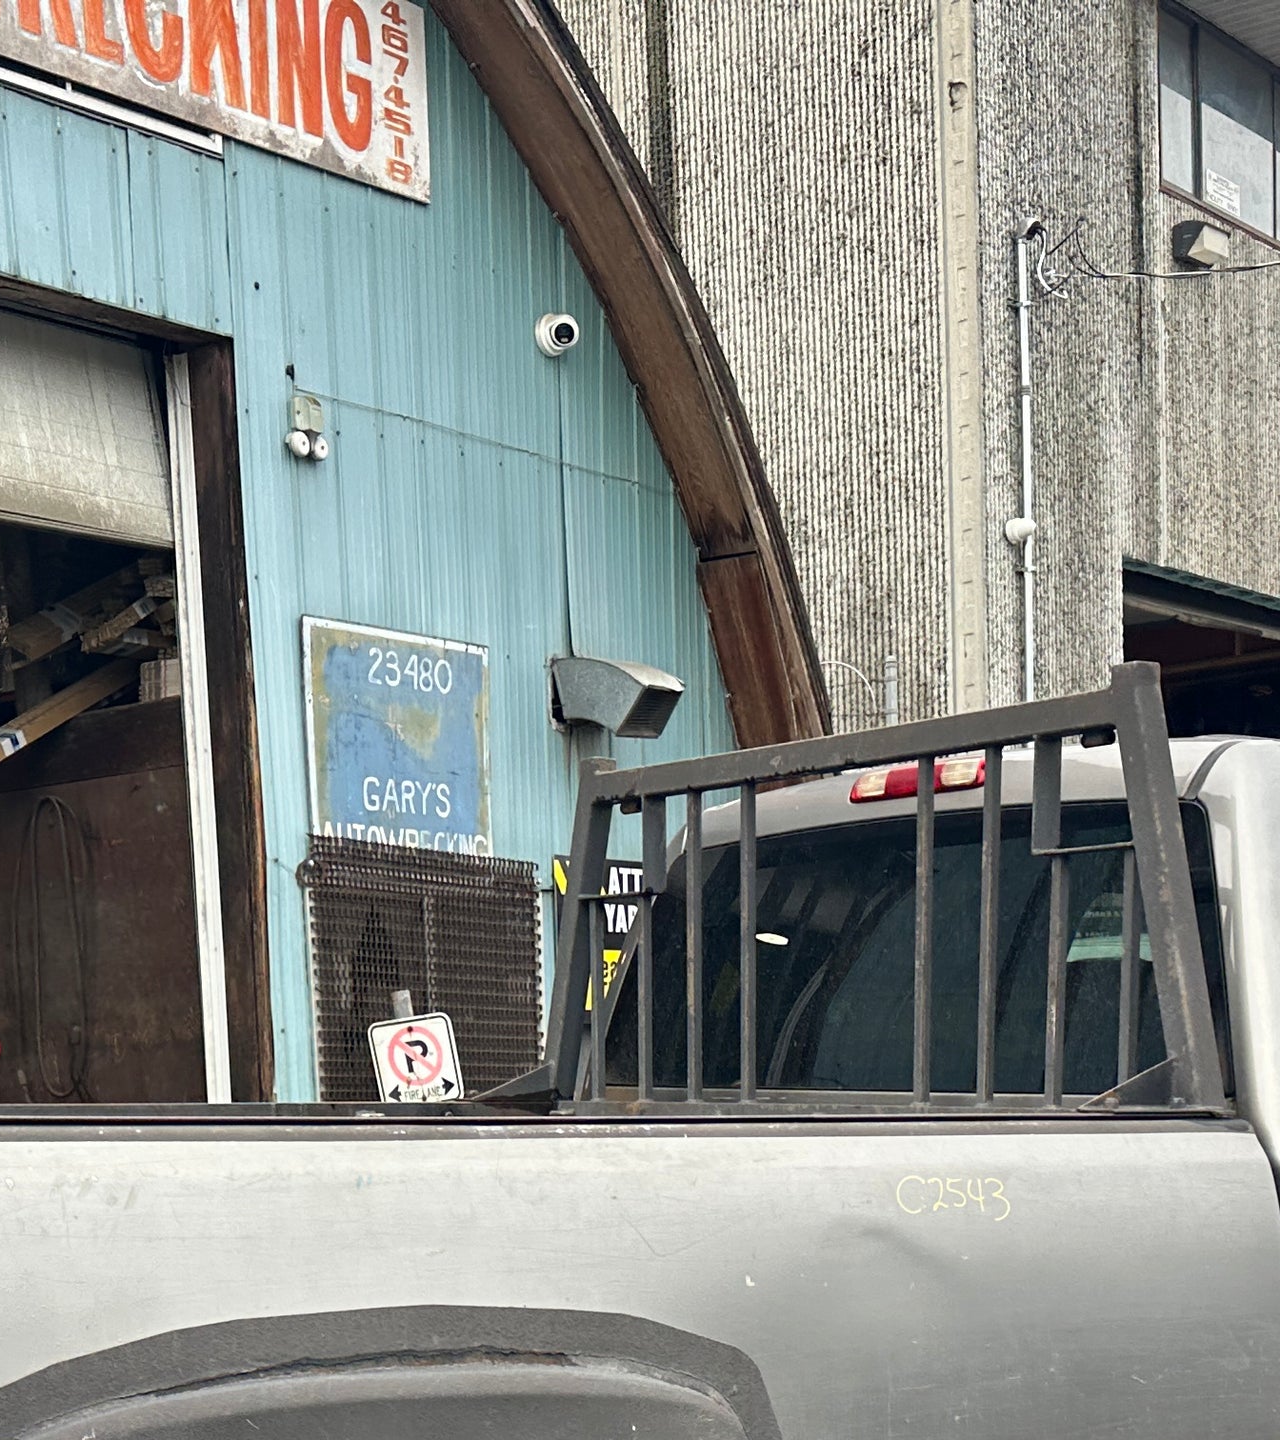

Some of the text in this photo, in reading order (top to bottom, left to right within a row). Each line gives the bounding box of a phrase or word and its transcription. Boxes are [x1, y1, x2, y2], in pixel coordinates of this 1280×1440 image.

[368, 647, 453, 695] 23480
[363, 776, 452, 819] GARY'S
[404, 1089, 422, 1101] FIRE
[896, 1175, 1011, 1221] C2543
